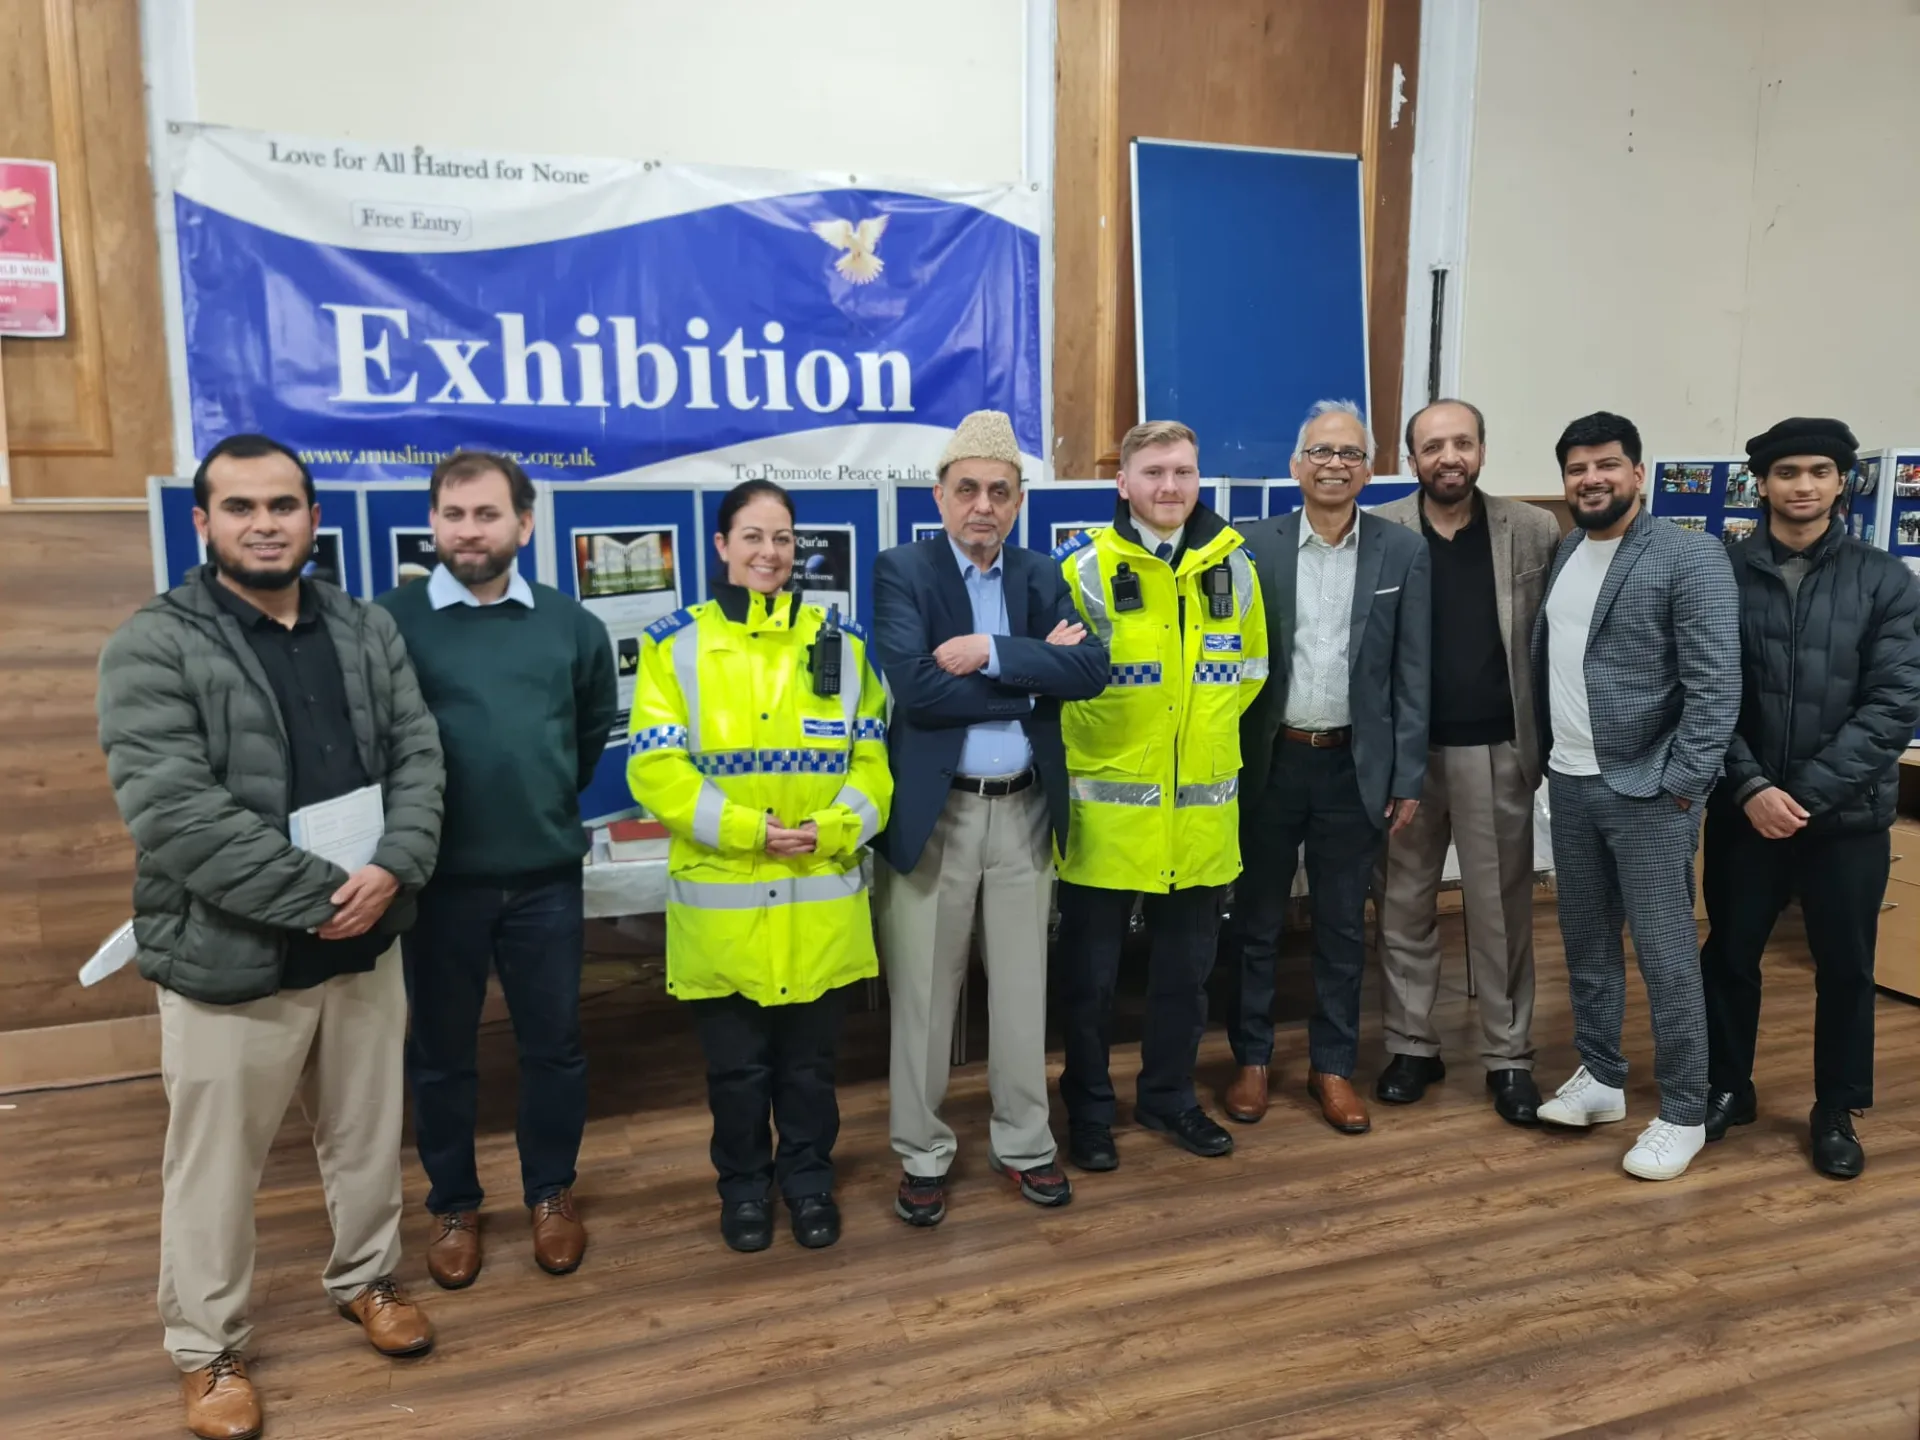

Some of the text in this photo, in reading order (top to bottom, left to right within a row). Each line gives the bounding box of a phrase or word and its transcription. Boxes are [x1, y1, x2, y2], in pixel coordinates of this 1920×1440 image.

[269, 142, 590, 185] Love for All Hatred for None
[360, 207, 463, 237] Free Entry
[321, 303, 915, 413] Exhibition
[731, 463, 932, 481] To Promote Peace in the
